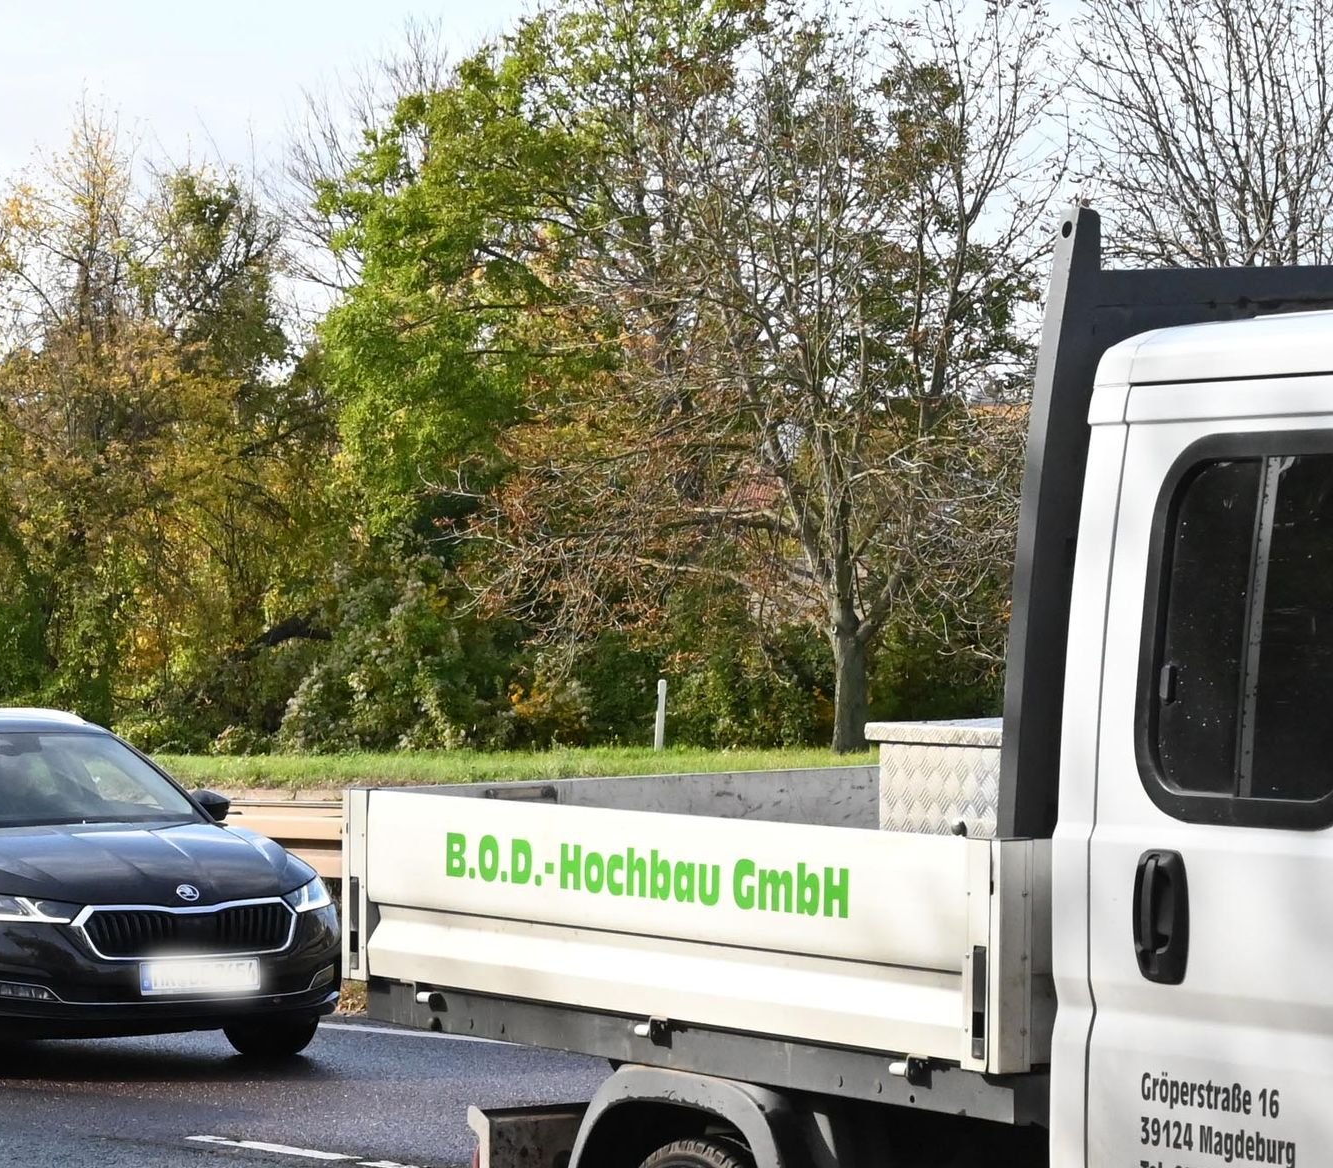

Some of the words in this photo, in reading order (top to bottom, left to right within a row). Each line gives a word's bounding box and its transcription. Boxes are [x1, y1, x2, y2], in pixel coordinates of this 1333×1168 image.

[445, 832, 721, 907] B.O.D.-Hochbau
[733, 858, 850, 918] GmbH
[1141, 1072, 1252, 1115] Gröperstraße
[1258, 1088, 1280, 1118] 16
[1140, 1116, 1193, 1151] 39124
